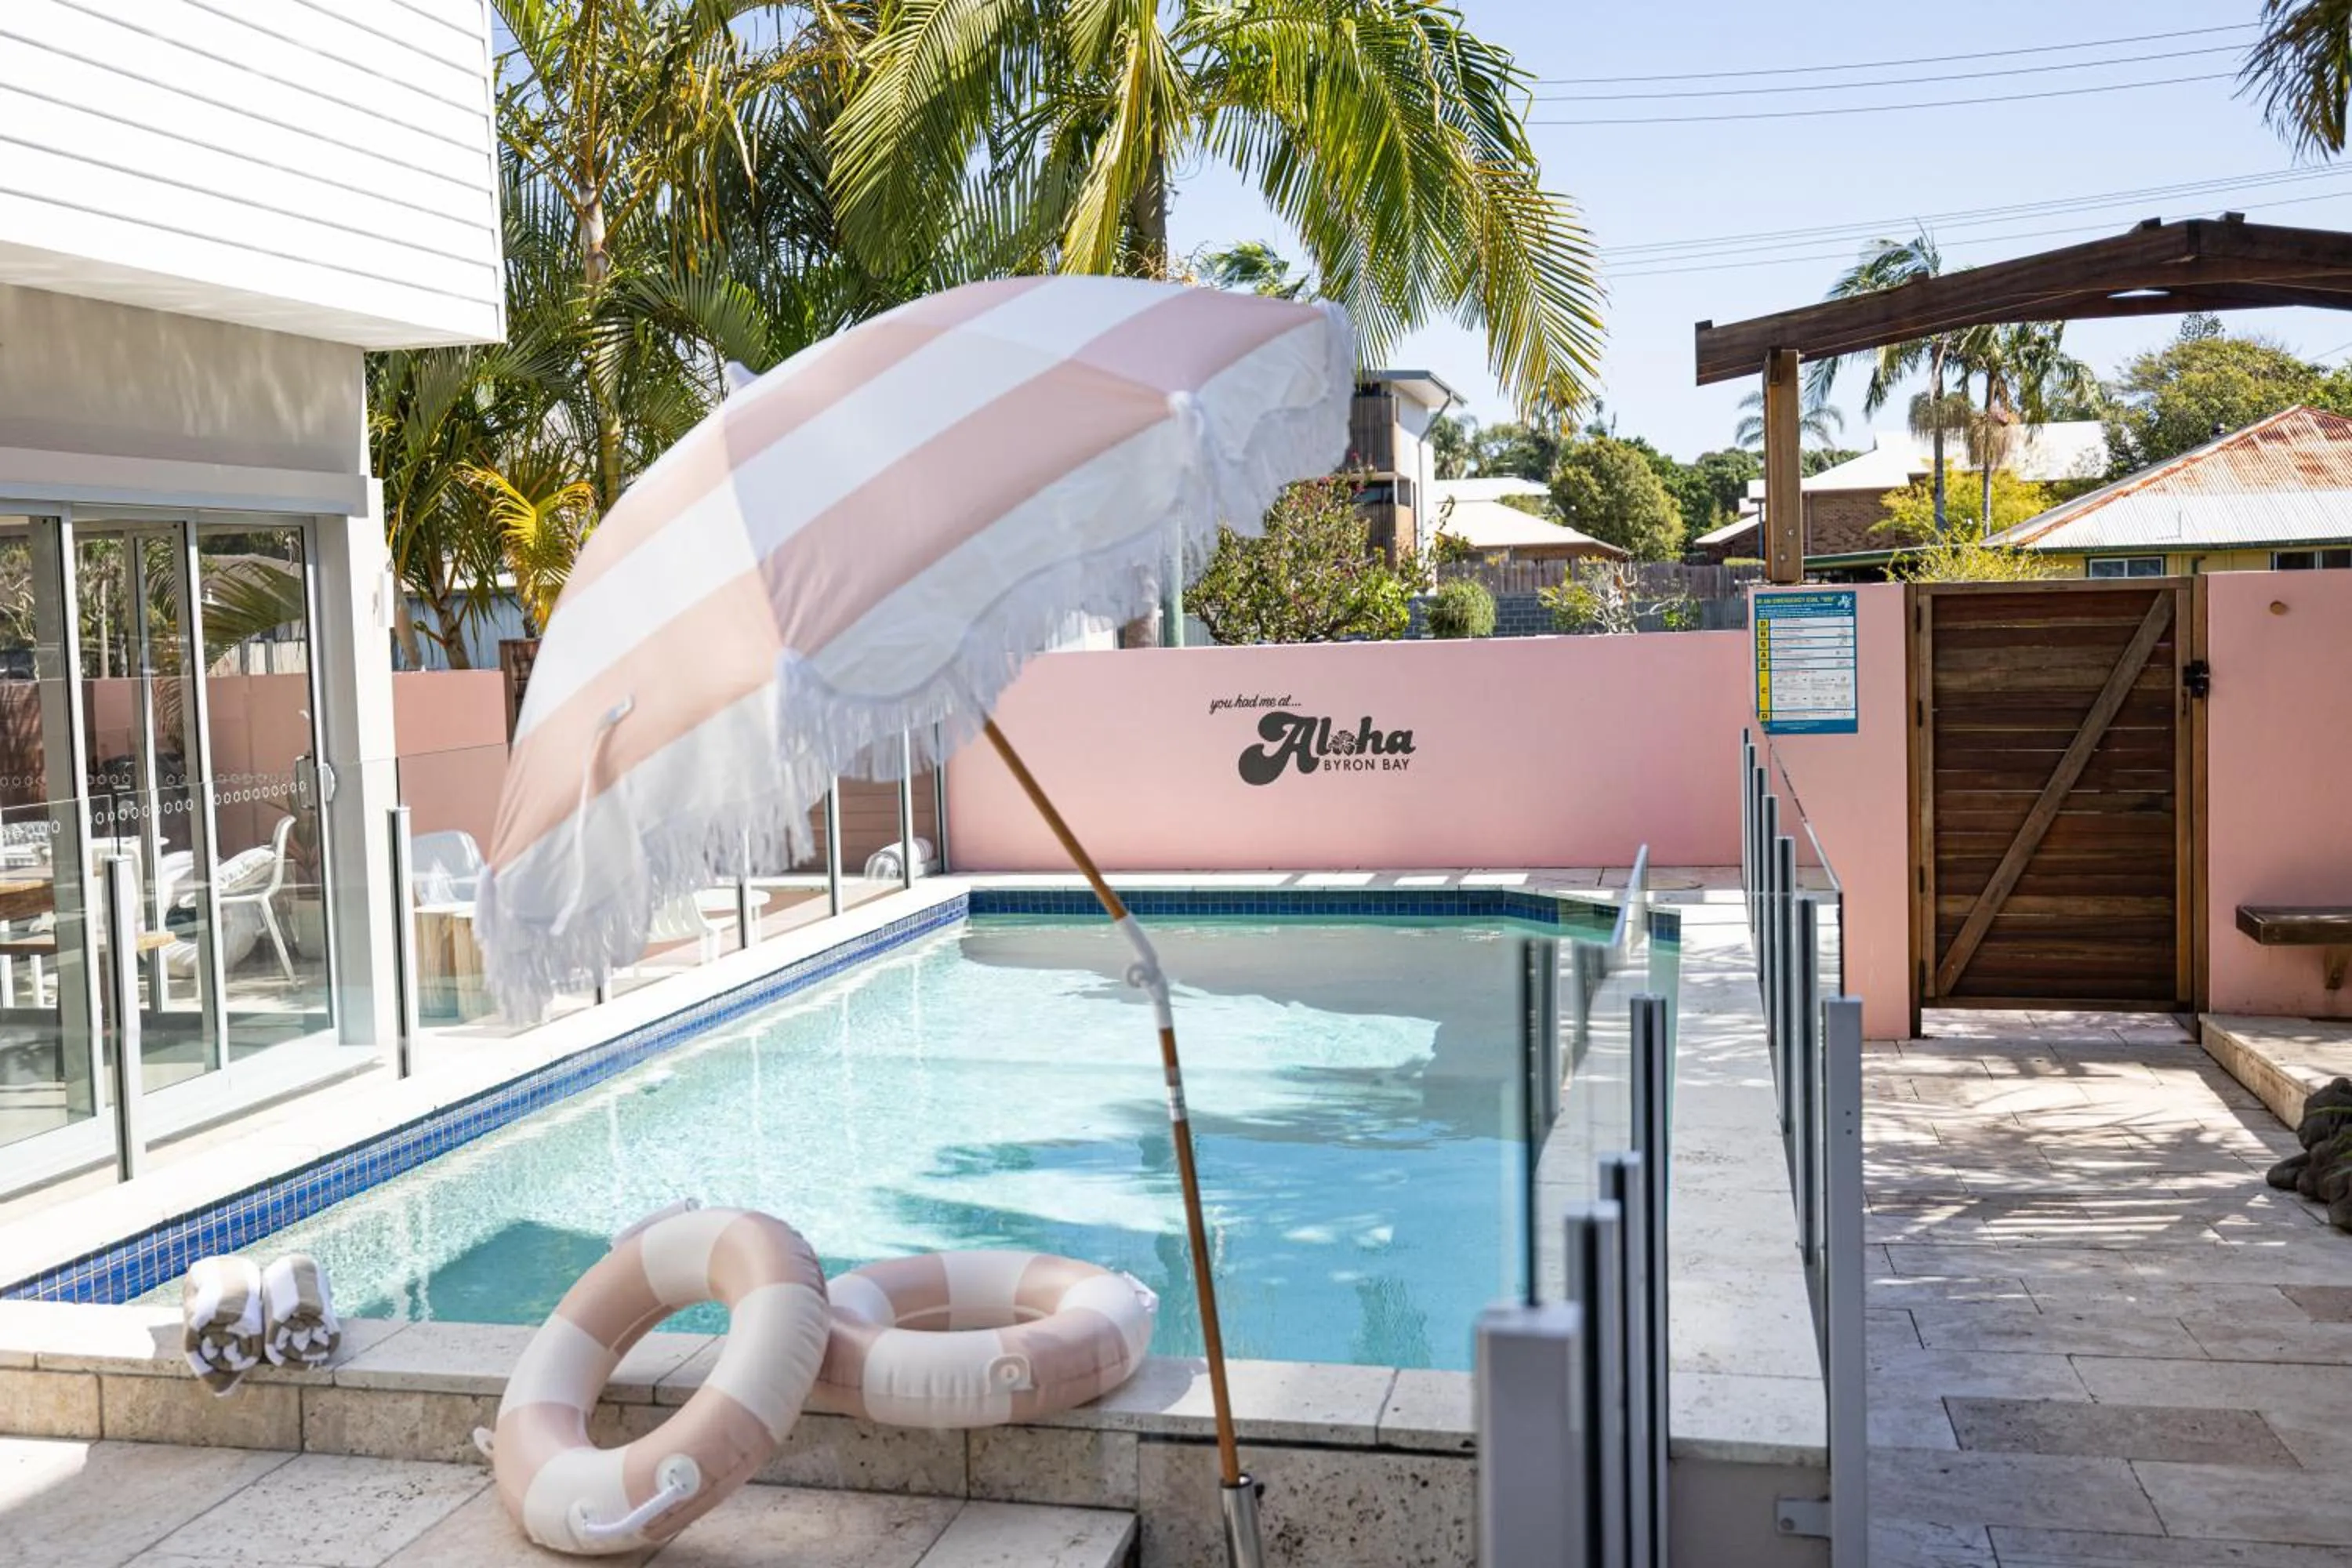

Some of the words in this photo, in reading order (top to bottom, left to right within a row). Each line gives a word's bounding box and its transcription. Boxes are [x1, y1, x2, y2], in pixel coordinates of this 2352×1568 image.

[1208, 698, 1234, 715] you
[1234, 694, 1259, 707] had
[1259, 698, 1277, 707] me
[1238, 710, 1417, 786] Aloha
[1323, 758, 1375, 771] BYRON
[1382, 757, 1410, 771] BAY
